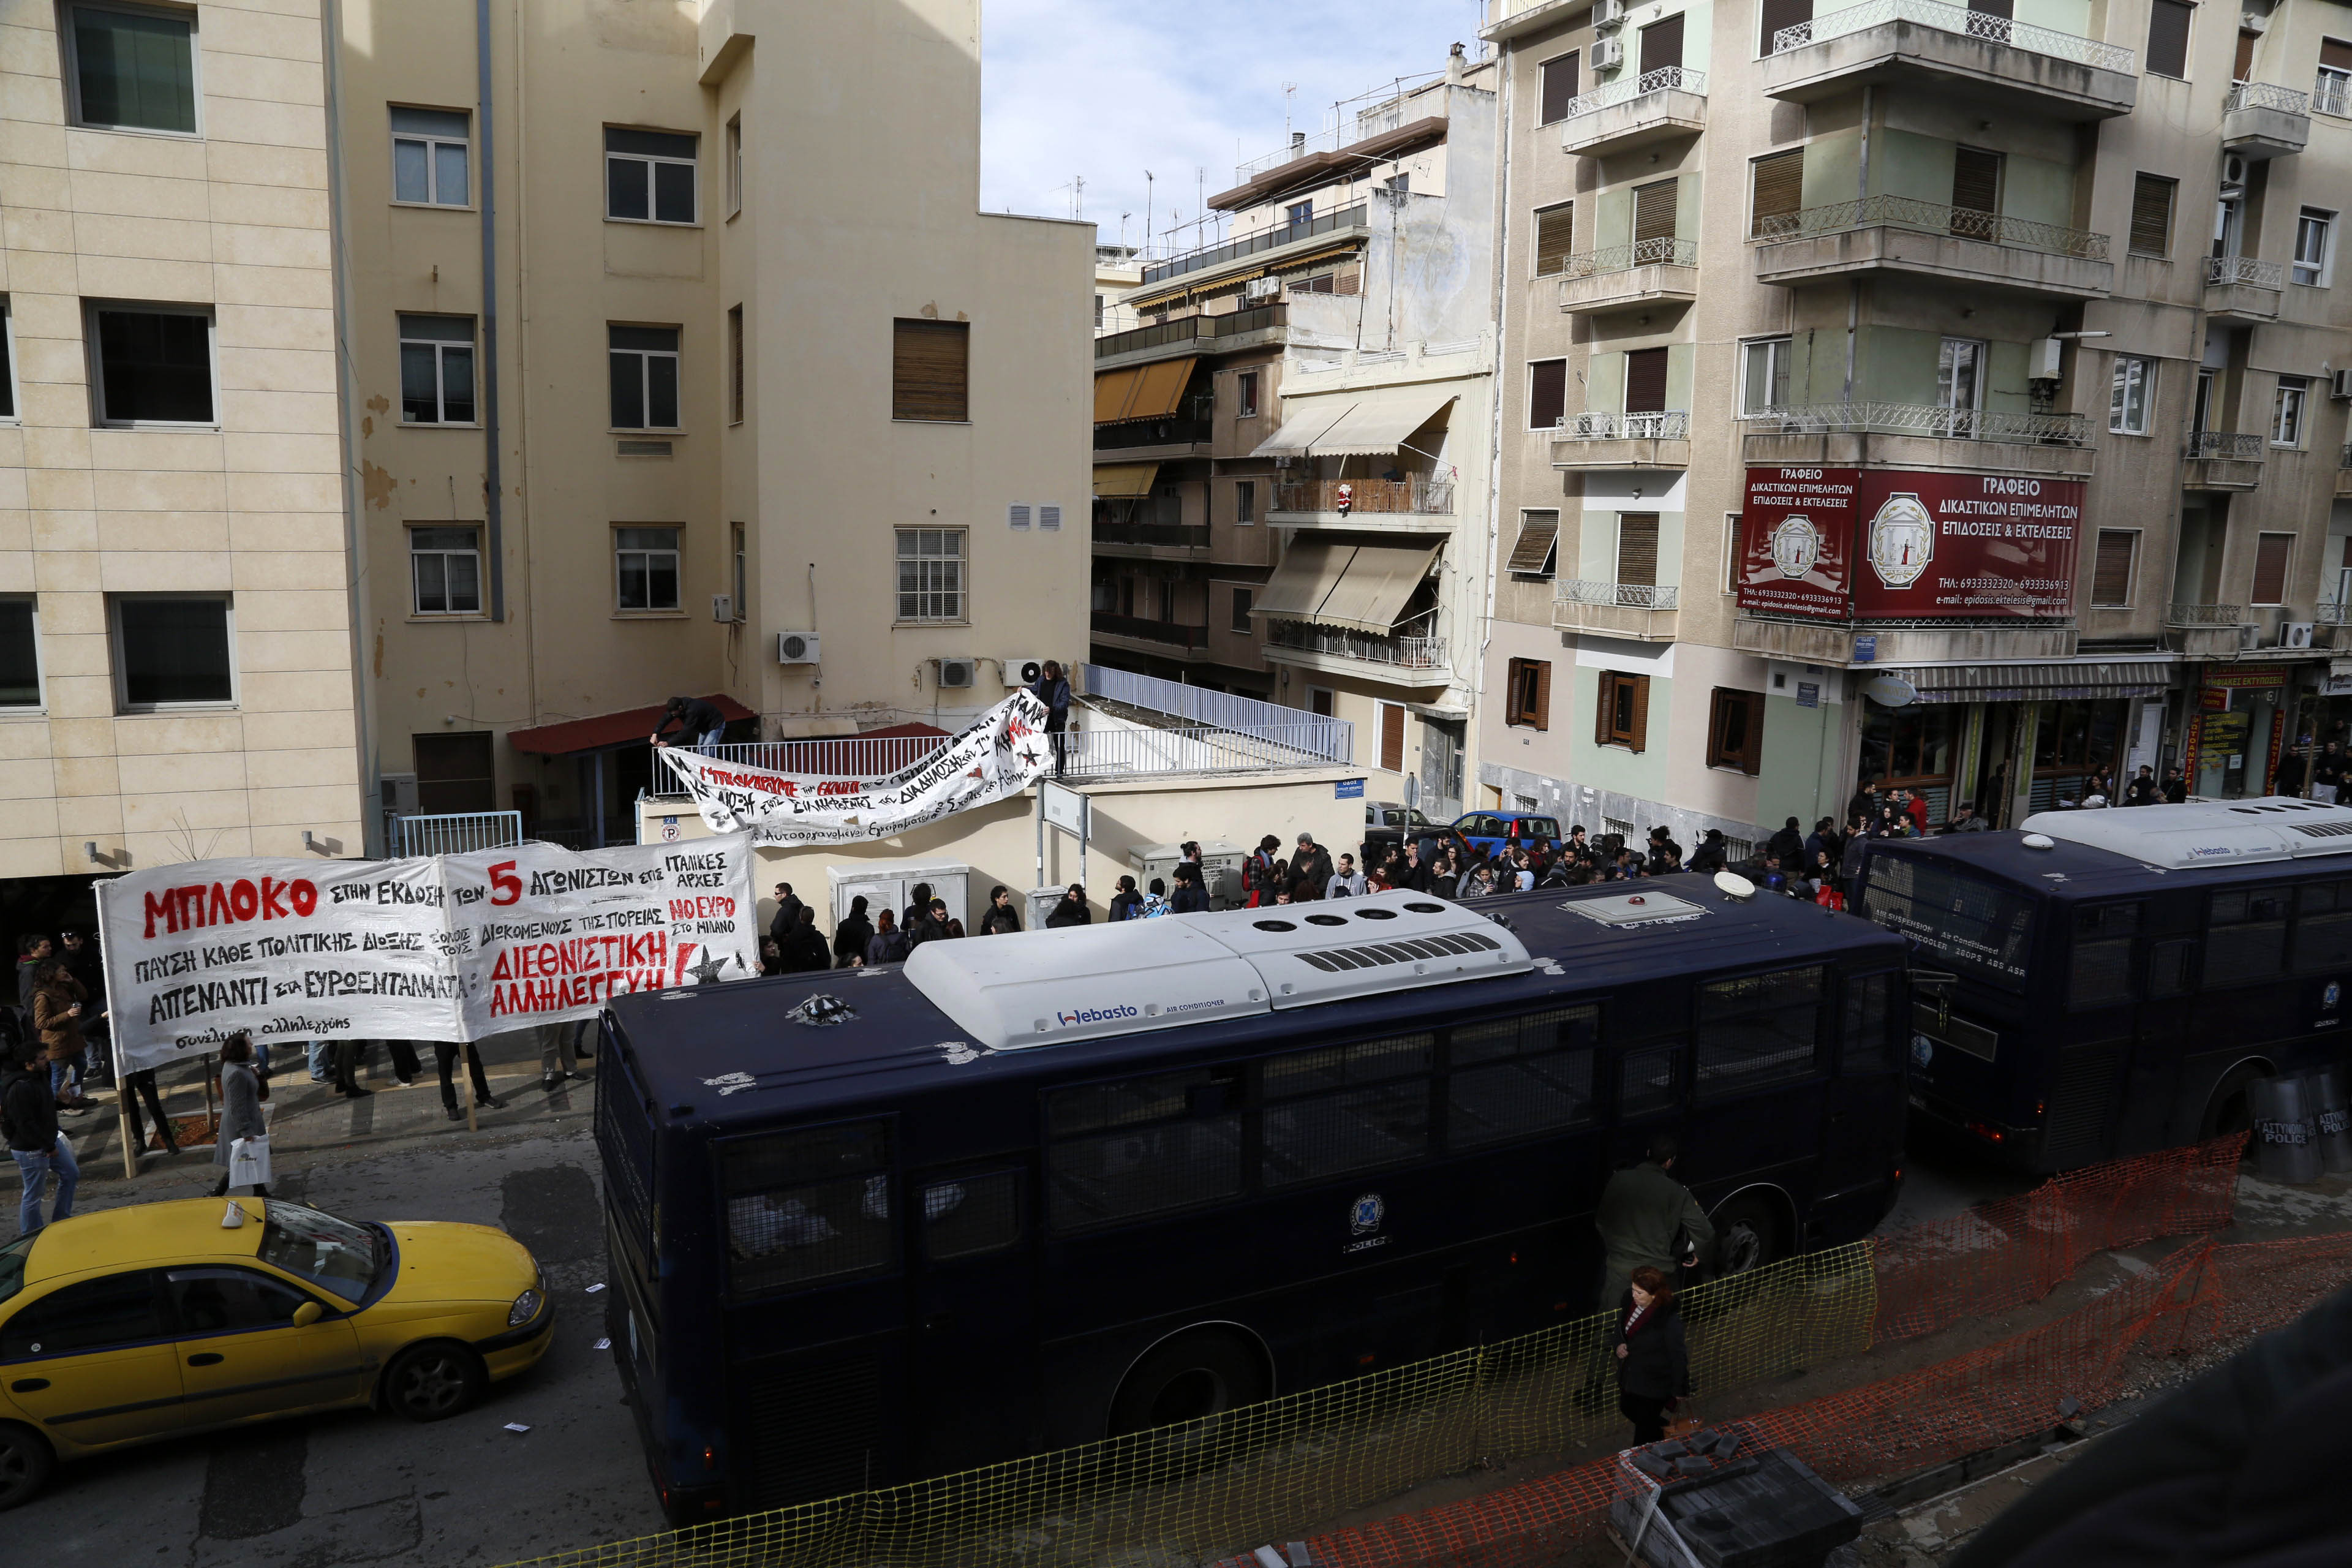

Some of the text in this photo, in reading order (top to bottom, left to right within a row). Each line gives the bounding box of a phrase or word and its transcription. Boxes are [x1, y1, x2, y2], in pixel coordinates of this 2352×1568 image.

[1781, 468, 1822, 480] ΓΡΑΦΕΙΟ
[1751, 483, 1853, 494] ΔΙΚΑΣΤΙΚΩΝ ΕΠΙΜΕΛΗΤΩΝ
[1983, 477, 2040, 497] ΓΡΑΦΕΙΟ
[1753, 496, 1847, 508] ΕΠΙΔΟΣΕΙΣ & ΕΚΤΕΛΕΣΕΙΣ
[1939, 499, 2078, 519] ΔΙΚΑΣΤΙΚΩΝ ΕΠΙΜΕΛΗΤΩΝ
[1942, 521, 2072, 540] ΕΠΙΔΟΣΕΙΣ & ΕΚΤΕΛΕΣΕΙΣ
[1939, 578, 2069, 591] ΤΗΛ: 6933332320 6933336913
[1743, 587, 1842, 605] ΤΗΛ: 6933332320 6933336913
[1936, 594, 2068, 608] e-mail: epidosis.ektelesis@gmail.com
[1761, 601, 1841, 615] epidosis.ektelesis@gmail.com
[2243, 676, 2284, 685] ΕΚΤΥΠΩΣΕΙΣ
[2185, 715, 2200, 796] ΦΩΤΟΑΝΤΙΓΡΑ
[985, 780, 997, 794] της
[2192, 846, 2230, 856] Webasto
[677, 872, 724, 888] ΑΡΧΕΣ
[143, 851, 728, 940] ΜΠΛΟΚΟ ΣΤΗΝ ΕΚΔΟΣΗ ΤΩΝ 5 ΑΓΩΝΙΣΤΩΝ ΣΤΙΣ ΙΤΑΛΙΚΕΣ
[481, 908, 735, 947] ΔΙΩΚΟΜΕΝΟΥΣ ΤΗΣ ΠΟΡΕΙΑΣ ΣΤΟ ΜΙΛΑΝΟ
[1888, 913, 1933, 933] SUSPENSION
[1940, 931, 1952, 940] Air
[1953, 935, 1999, 956] Conditioned
[438, 940, 472, 957] ΤΟΥΣ
[491, 930, 668, 982] ΔΙΕΘΝΙΣΤΙΚΗ
[1899, 929, 1948, 951] NTERCOOLER
[1987, 958, 2005, 970] ABS
[135, 951, 197, 984] ΠΑΥΣΗ
[203, 942, 254, 969] ΚΑΘΕ
[257, 932, 357, 959] ΠΟΛΙΤΙΚΗΣ
[363, 932, 424, 952] ΔΙΩΞΗΣ
[149, 976, 268, 1025] ΑΠΕΝΑΝΤΙ
[274, 981, 303, 998] ΣΤΑ
[1057, 1004, 1137, 1027] Webasto
[1179, 999, 1225, 1012] CONDITIONER
[262, 1016, 350, 1034] αλληλεγγύης
[2323, 1120, 2350, 1134] POLIC
[2265, 1133, 2307, 1144] POLICE
